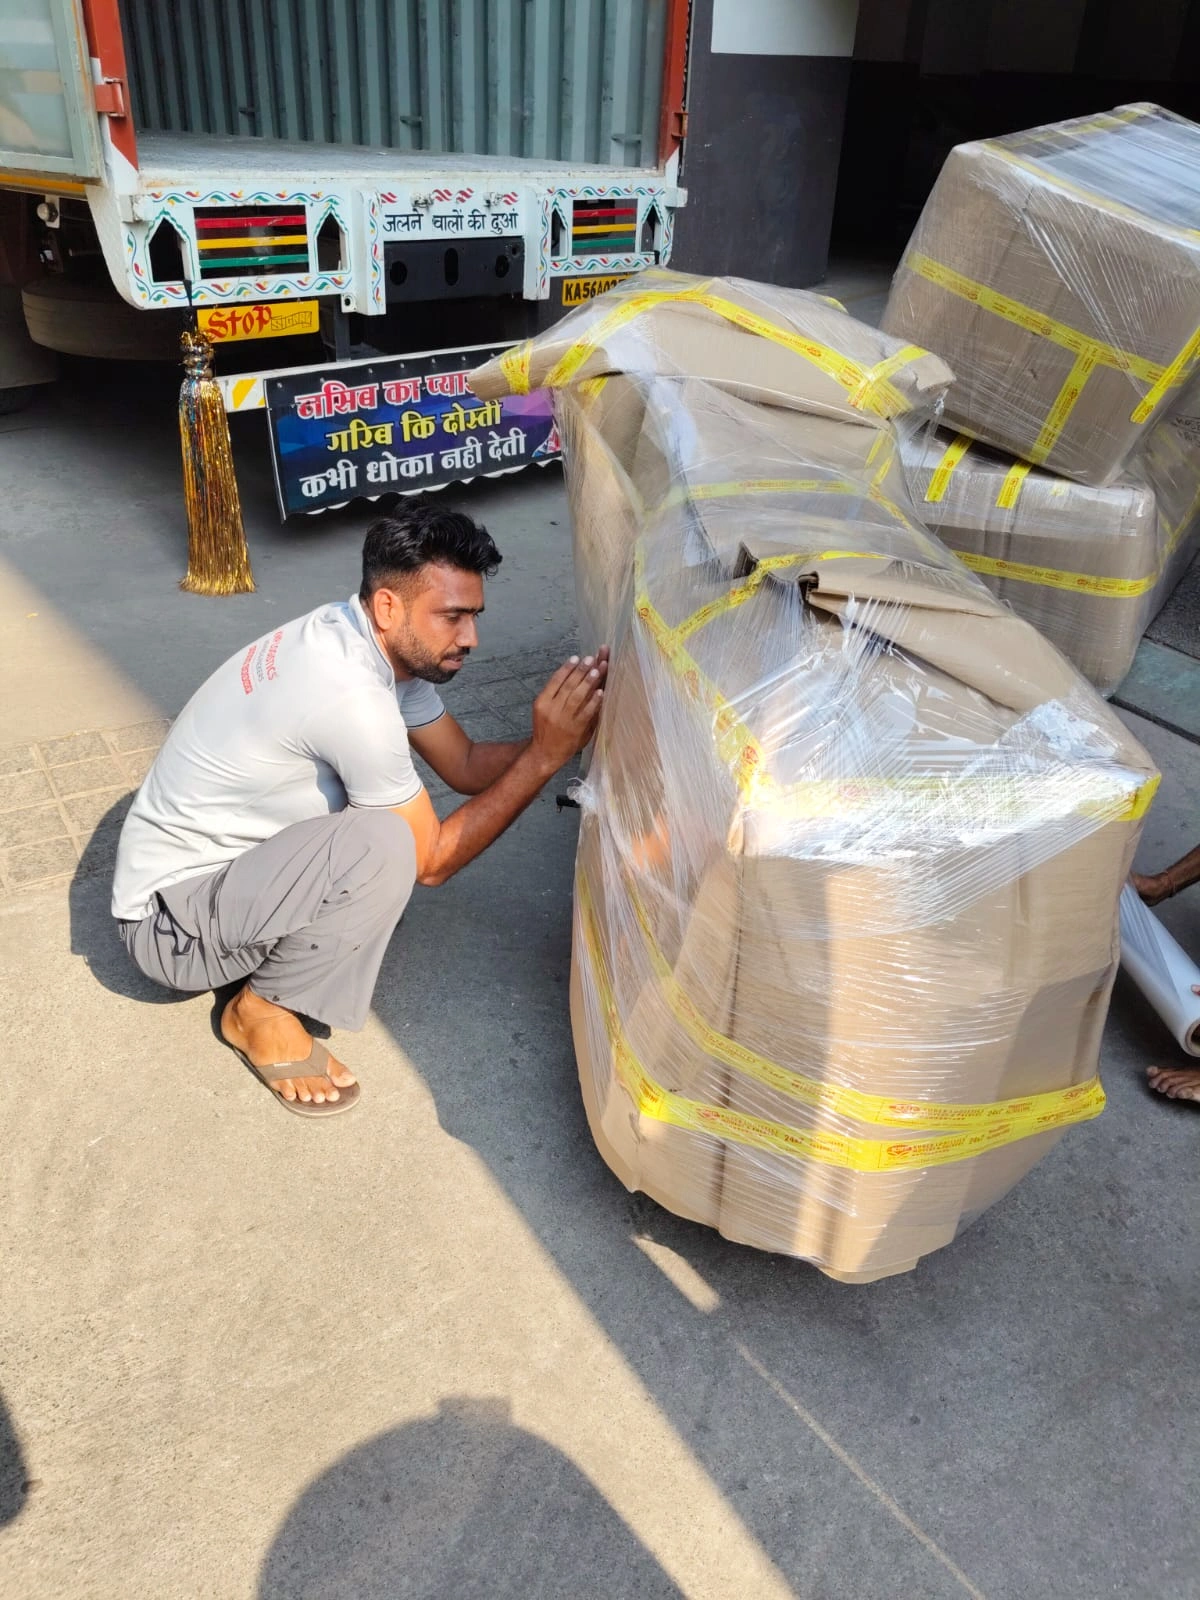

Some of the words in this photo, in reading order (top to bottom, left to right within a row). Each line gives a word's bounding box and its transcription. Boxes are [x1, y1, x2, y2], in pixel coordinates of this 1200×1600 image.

[383, 208, 424, 232] जलने
[467, 209, 487, 231] की
[294, 379, 380, 420] नसिब
[382, 377, 422, 406] का
[325, 419, 394, 453] गरिब
[400, 410, 436, 442] कि
[299, 458, 358, 498] कभी
[366, 451, 434, 483] धोका
[439, 436, 483, 469] नही
[487, 427, 527, 461] देती
